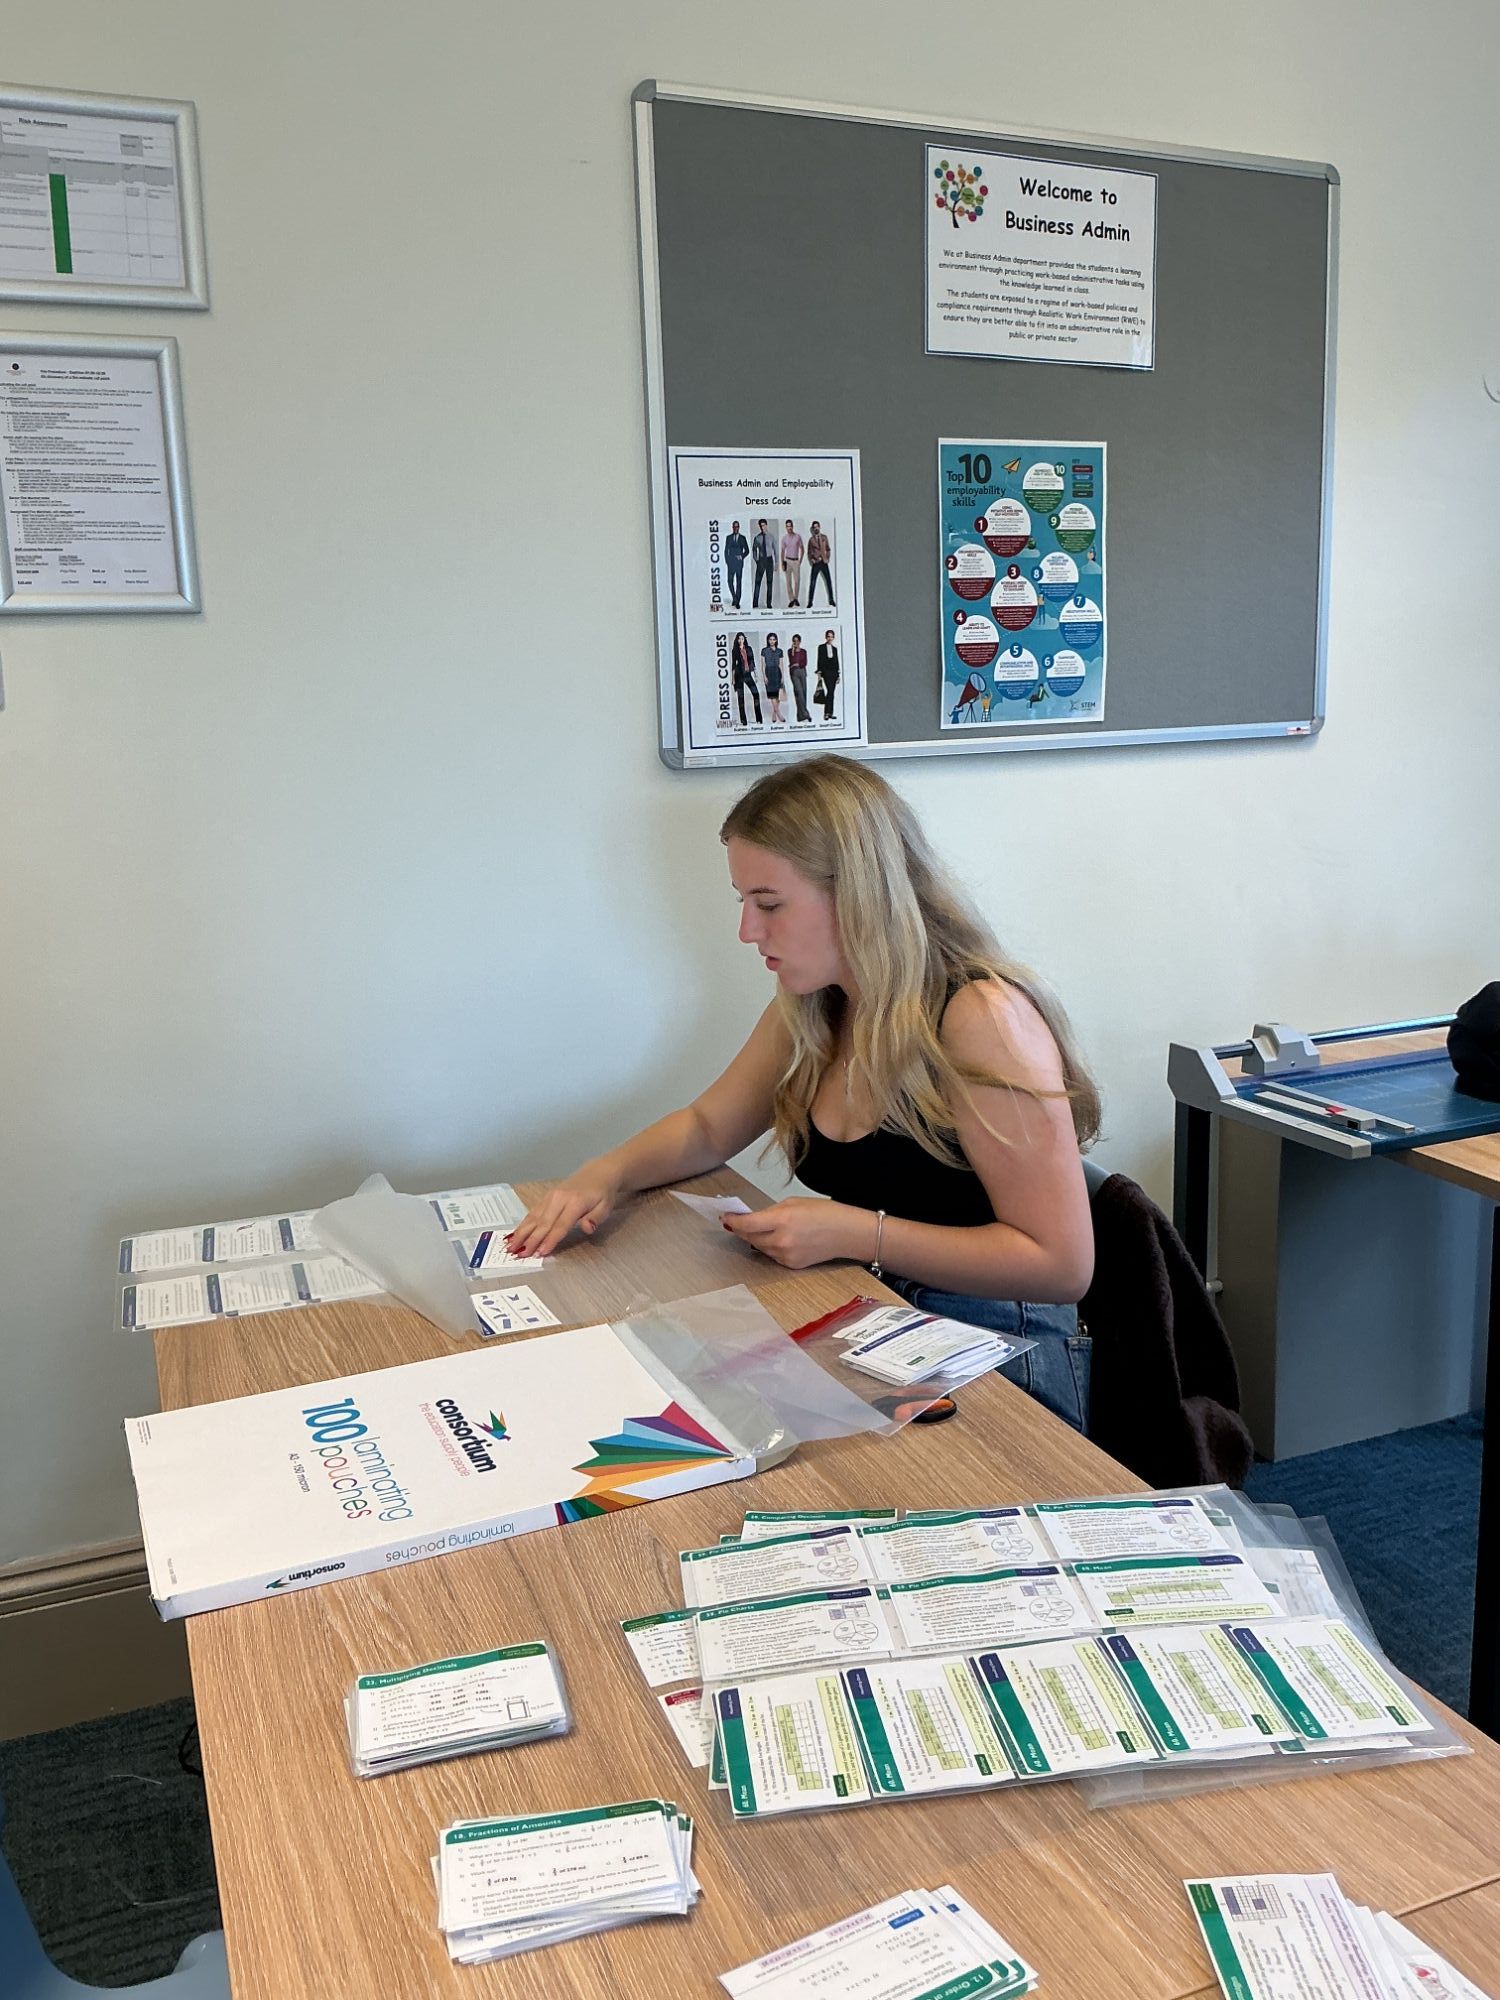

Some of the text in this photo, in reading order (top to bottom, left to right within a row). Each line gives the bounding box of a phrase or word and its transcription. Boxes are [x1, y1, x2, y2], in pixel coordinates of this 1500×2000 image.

[1019, 176, 1117, 205] Welcome to
[1005, 210, 1130, 242] Business Admin
[947, 454, 992, 485] Top 10
[698, 478, 732, 487] Business
[782, 480, 833, 489] Employability
[947, 486, 1006, 497] employability
[746, 497, 791, 505] Dress Code
[952, 499, 975, 507] skills
[978, 520, 983, 530] 1
[1051, 516, 1056, 526] 9
[709, 520, 720, 603] DRESS CODES
[948, 558, 954, 567] 2
[1010, 568, 1016, 576] 3
[1034, 569, 1039, 578] 8
[1076, 596, 1082, 605] 7
[957, 613, 963, 622] 4
[1013, 645, 1019, 655] 5
[1045, 658, 1050, 666] 6
[716, 634, 730, 720] DRESS CODES
[302, 1398, 368, 1443] 100
[436, 1399, 497, 1473] consortium
[311, 1444, 372, 1519] pouches
[352, 1437, 413, 1522] laminating
[385, 1522, 514, 1563] laminating pouches
[288, 1562, 346, 1582] consortium
[379, 1662, 458, 1685] Multiplying Decimals
[1161, 1721, 1175, 1736] Mean
[1026, 1742, 1038, 1758] Mean
[882, 1763, 893, 1778] Mean
[739, 1784, 748, 1799] Mean
[469, 1827, 509, 1838] Fractions
[522, 1819, 562, 1829] Amounts
[968, 1973, 985, 1984] 12.
[942, 1980, 971, 1996] Order
